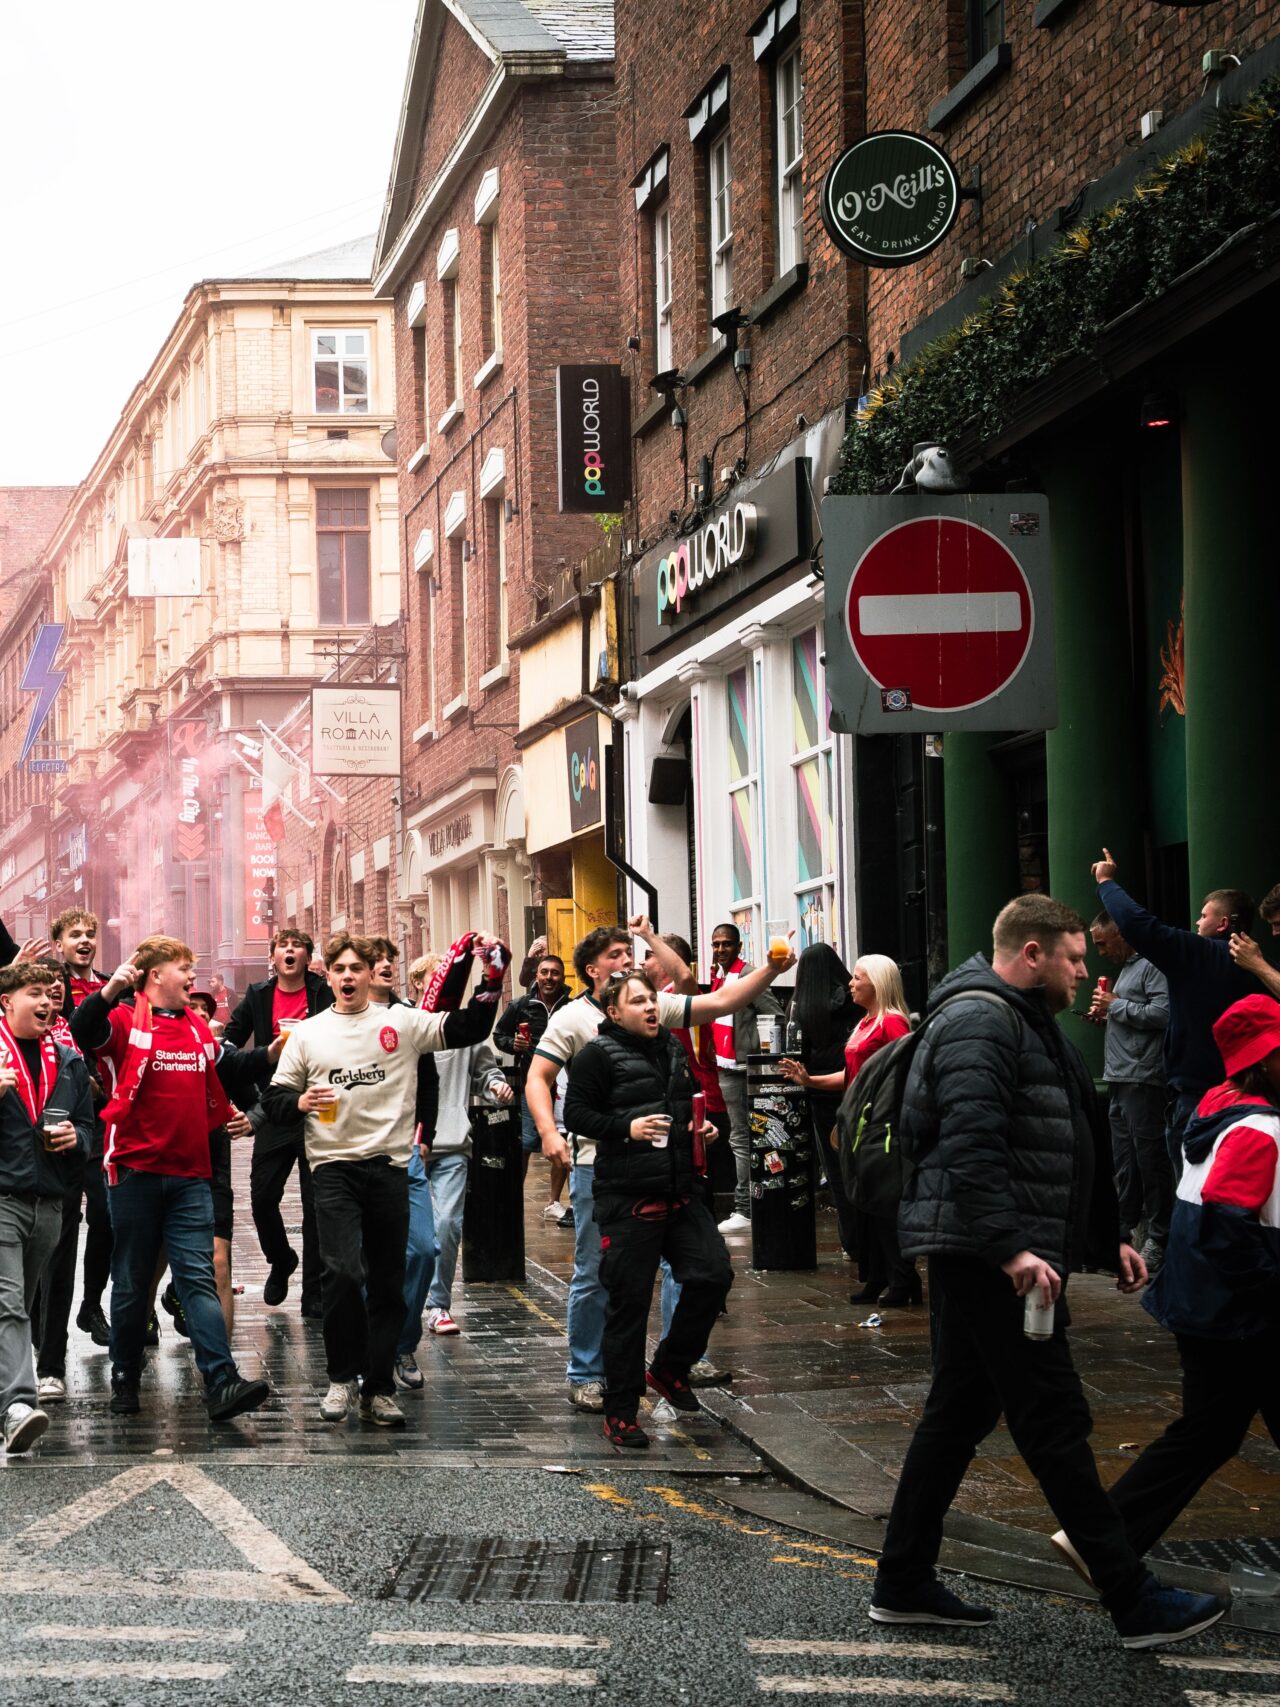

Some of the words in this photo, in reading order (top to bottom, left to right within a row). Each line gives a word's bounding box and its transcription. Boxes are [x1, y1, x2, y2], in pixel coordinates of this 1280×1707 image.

[837, 164, 945, 222] O'Neill's
[850, 225, 872, 243] EAT
[882, 234, 921, 249] DRINK
[927, 193, 947, 231] ENJOY
[333, 711, 380, 724] VILLA
[182, 775, 200, 797] The
[179, 799, 201, 823] City
[252, 868, 276, 878] NOW
[152, 1061, 197, 1072] Chartered
[155, 1050, 197, 1061] Standard
[328, 1063, 386, 1091] Carlsberg
